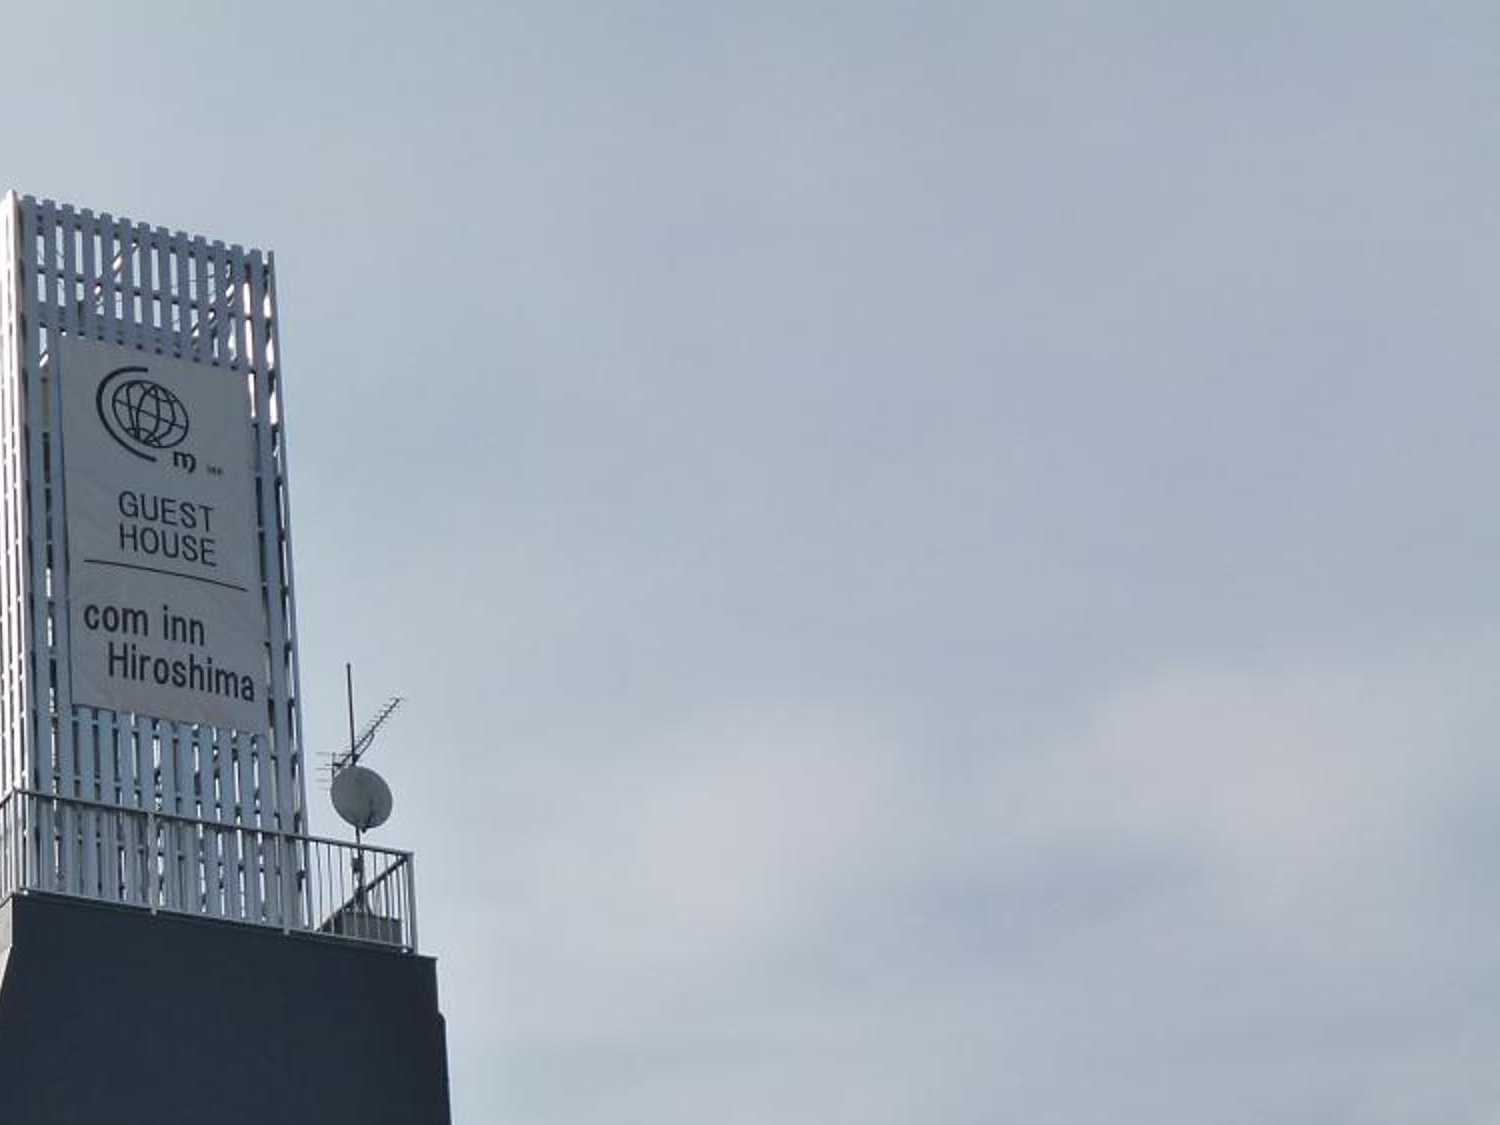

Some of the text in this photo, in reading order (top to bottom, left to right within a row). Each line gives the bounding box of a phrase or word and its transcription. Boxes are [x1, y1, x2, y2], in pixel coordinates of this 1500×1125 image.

[119, 490, 214, 533] GUEST
[119, 523, 218, 567] HOUSE
[84, 603, 205, 646] com inn
[108, 641, 255, 702] Hiroshima
